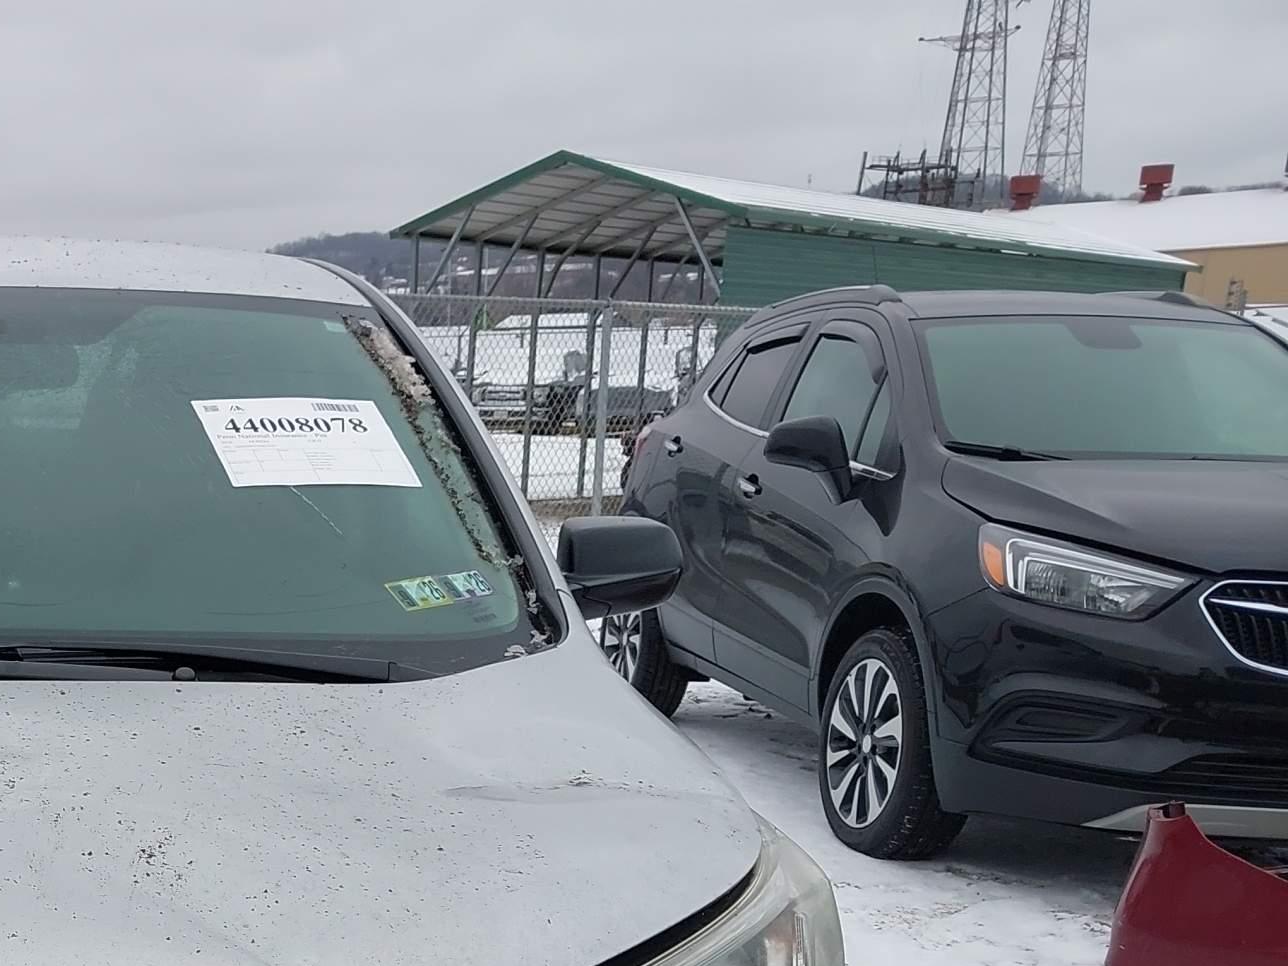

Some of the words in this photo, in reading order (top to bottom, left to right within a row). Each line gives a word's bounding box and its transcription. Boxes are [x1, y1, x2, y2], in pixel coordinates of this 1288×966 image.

[224, 417, 368, 433] 44008078
[421, 580, 445, 600] 26
[467, 572, 491, 592] 26
